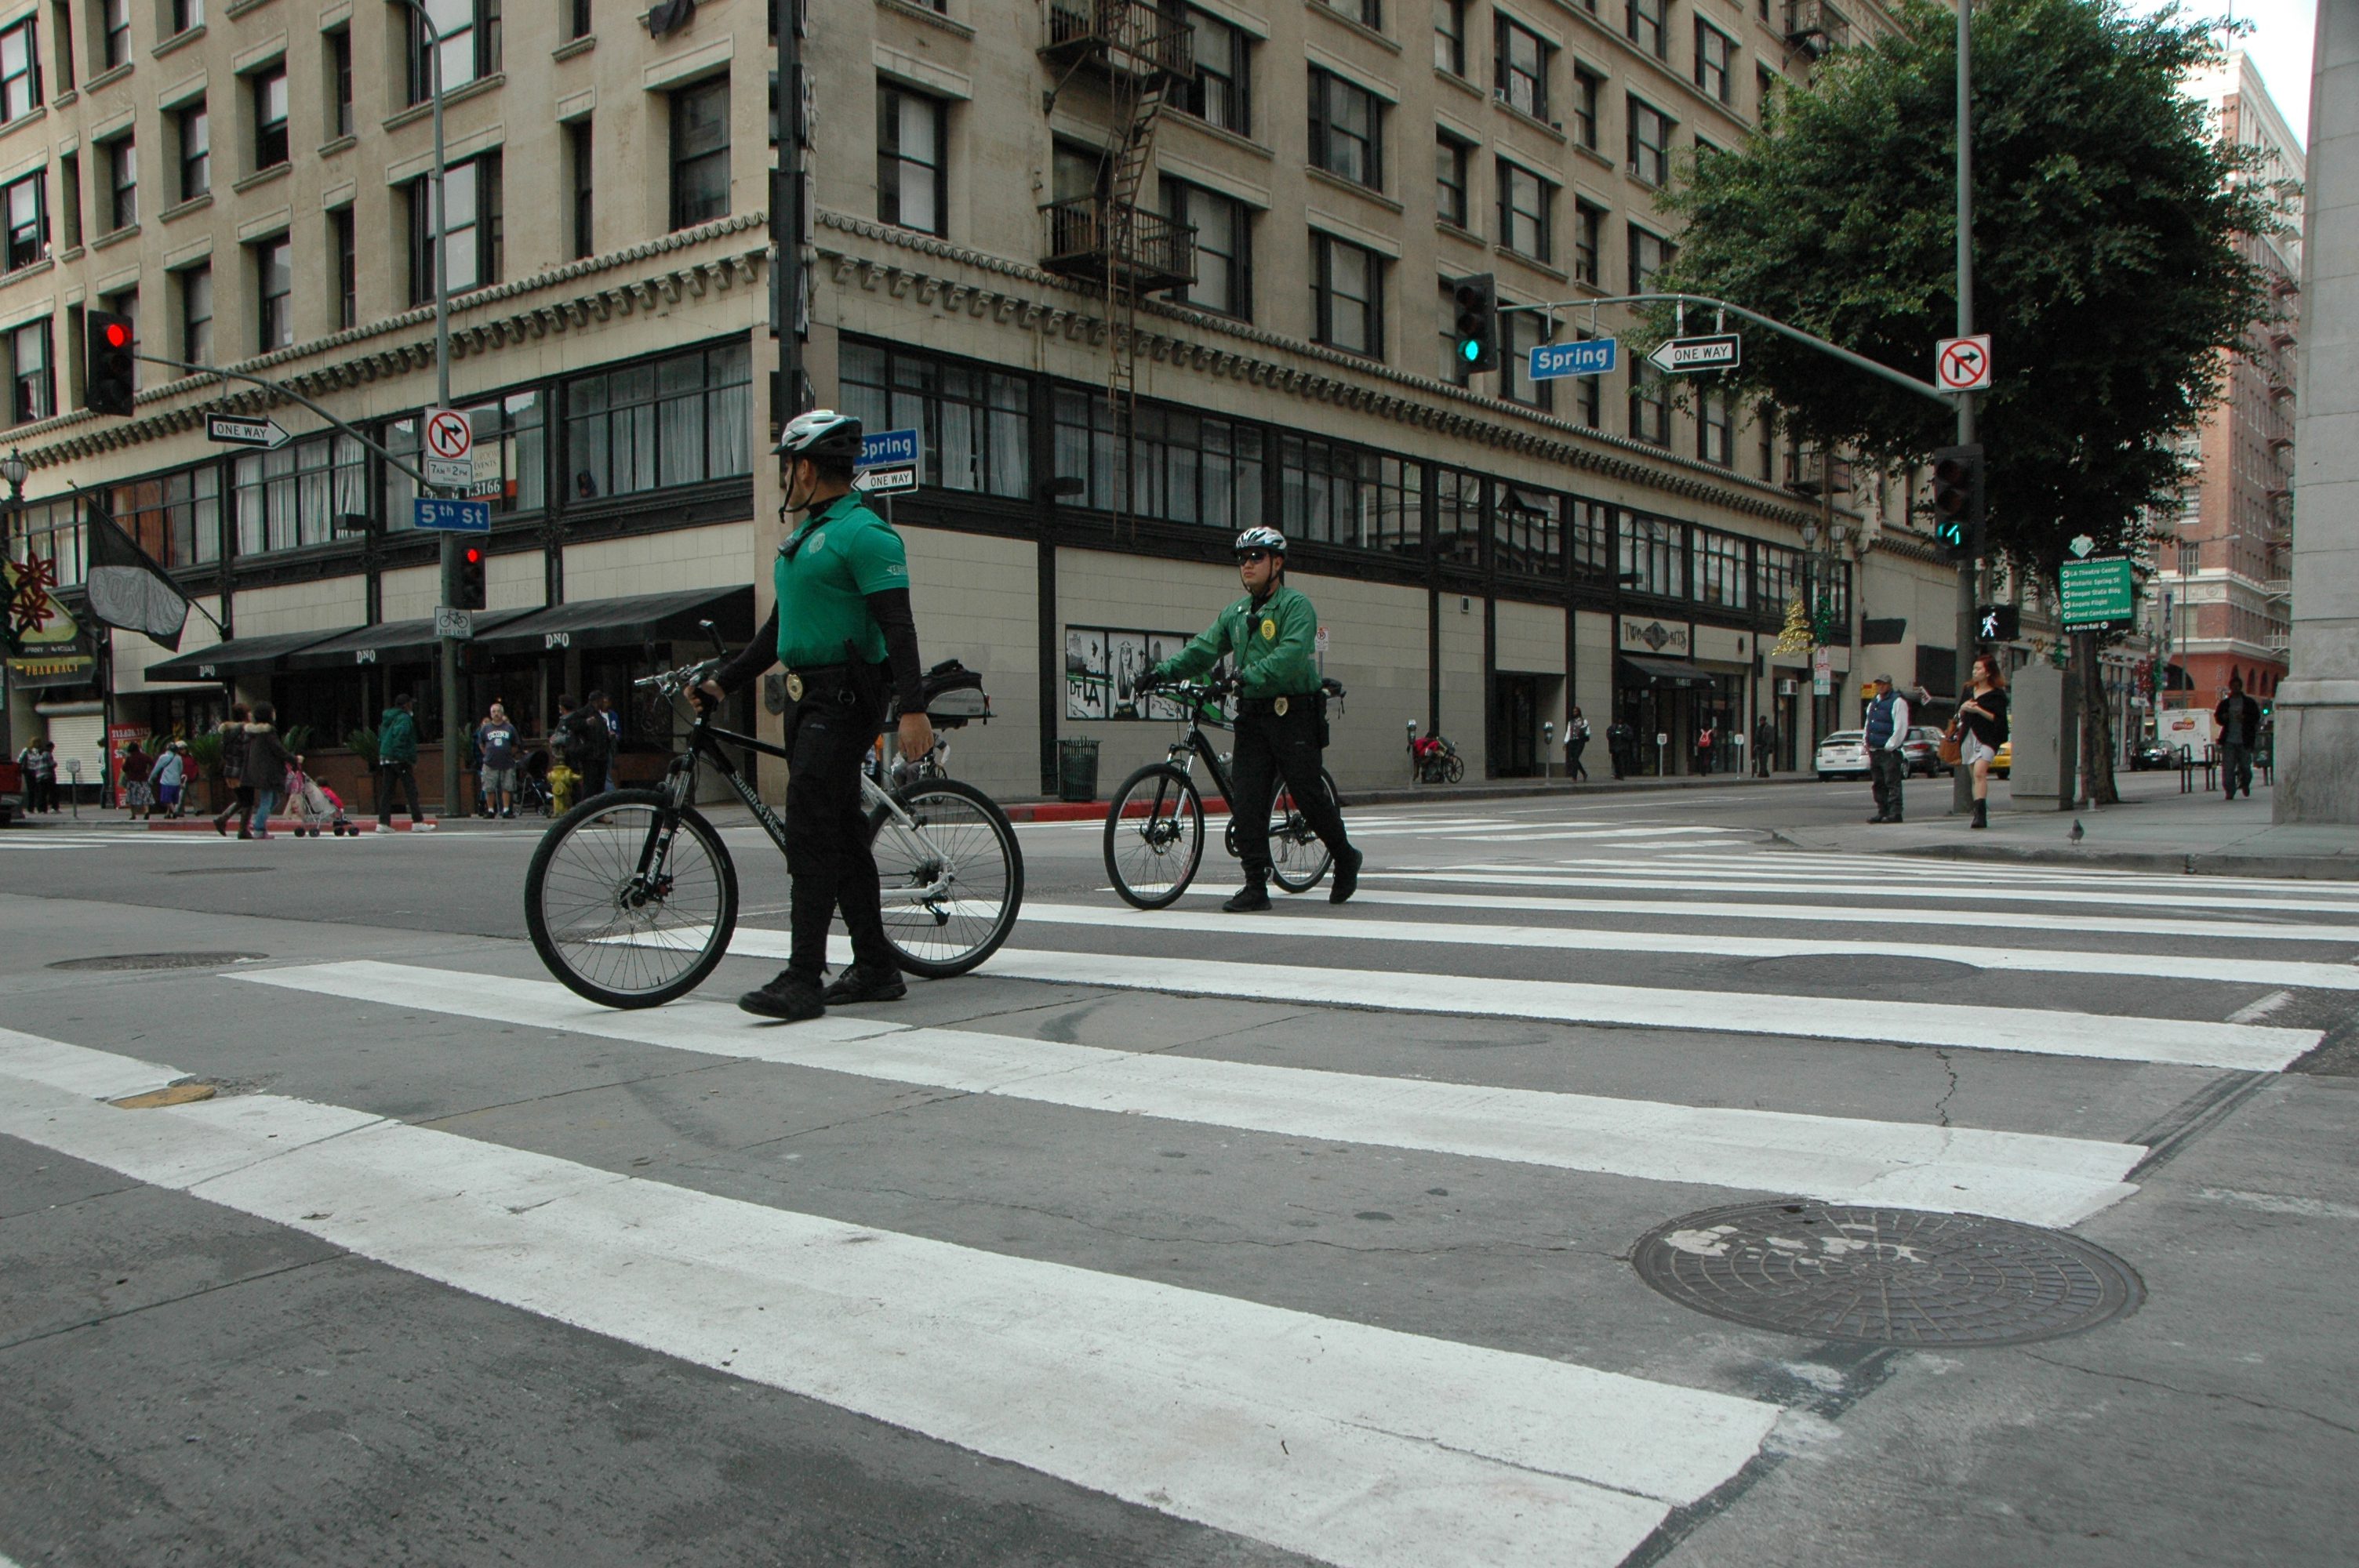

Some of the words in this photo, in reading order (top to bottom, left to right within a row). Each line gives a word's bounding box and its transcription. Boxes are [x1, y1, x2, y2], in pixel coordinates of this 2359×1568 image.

[1538, 348, 1607, 371] Spring
[1674, 348, 1699, 361] ONE
[1703, 345, 1728, 358] WAY
[216, 424, 240, 436] ONE
[245, 427, 267, 438] WAY
[861, 437, 911, 459] Spring
[871, 475, 889, 487] ONE
[891, 473, 910, 484] WAY
[421, 504, 454, 523] 5th
[462, 508, 483, 524] St
[546, 633, 569, 649] DNO
[357, 650, 376, 664] DNO
